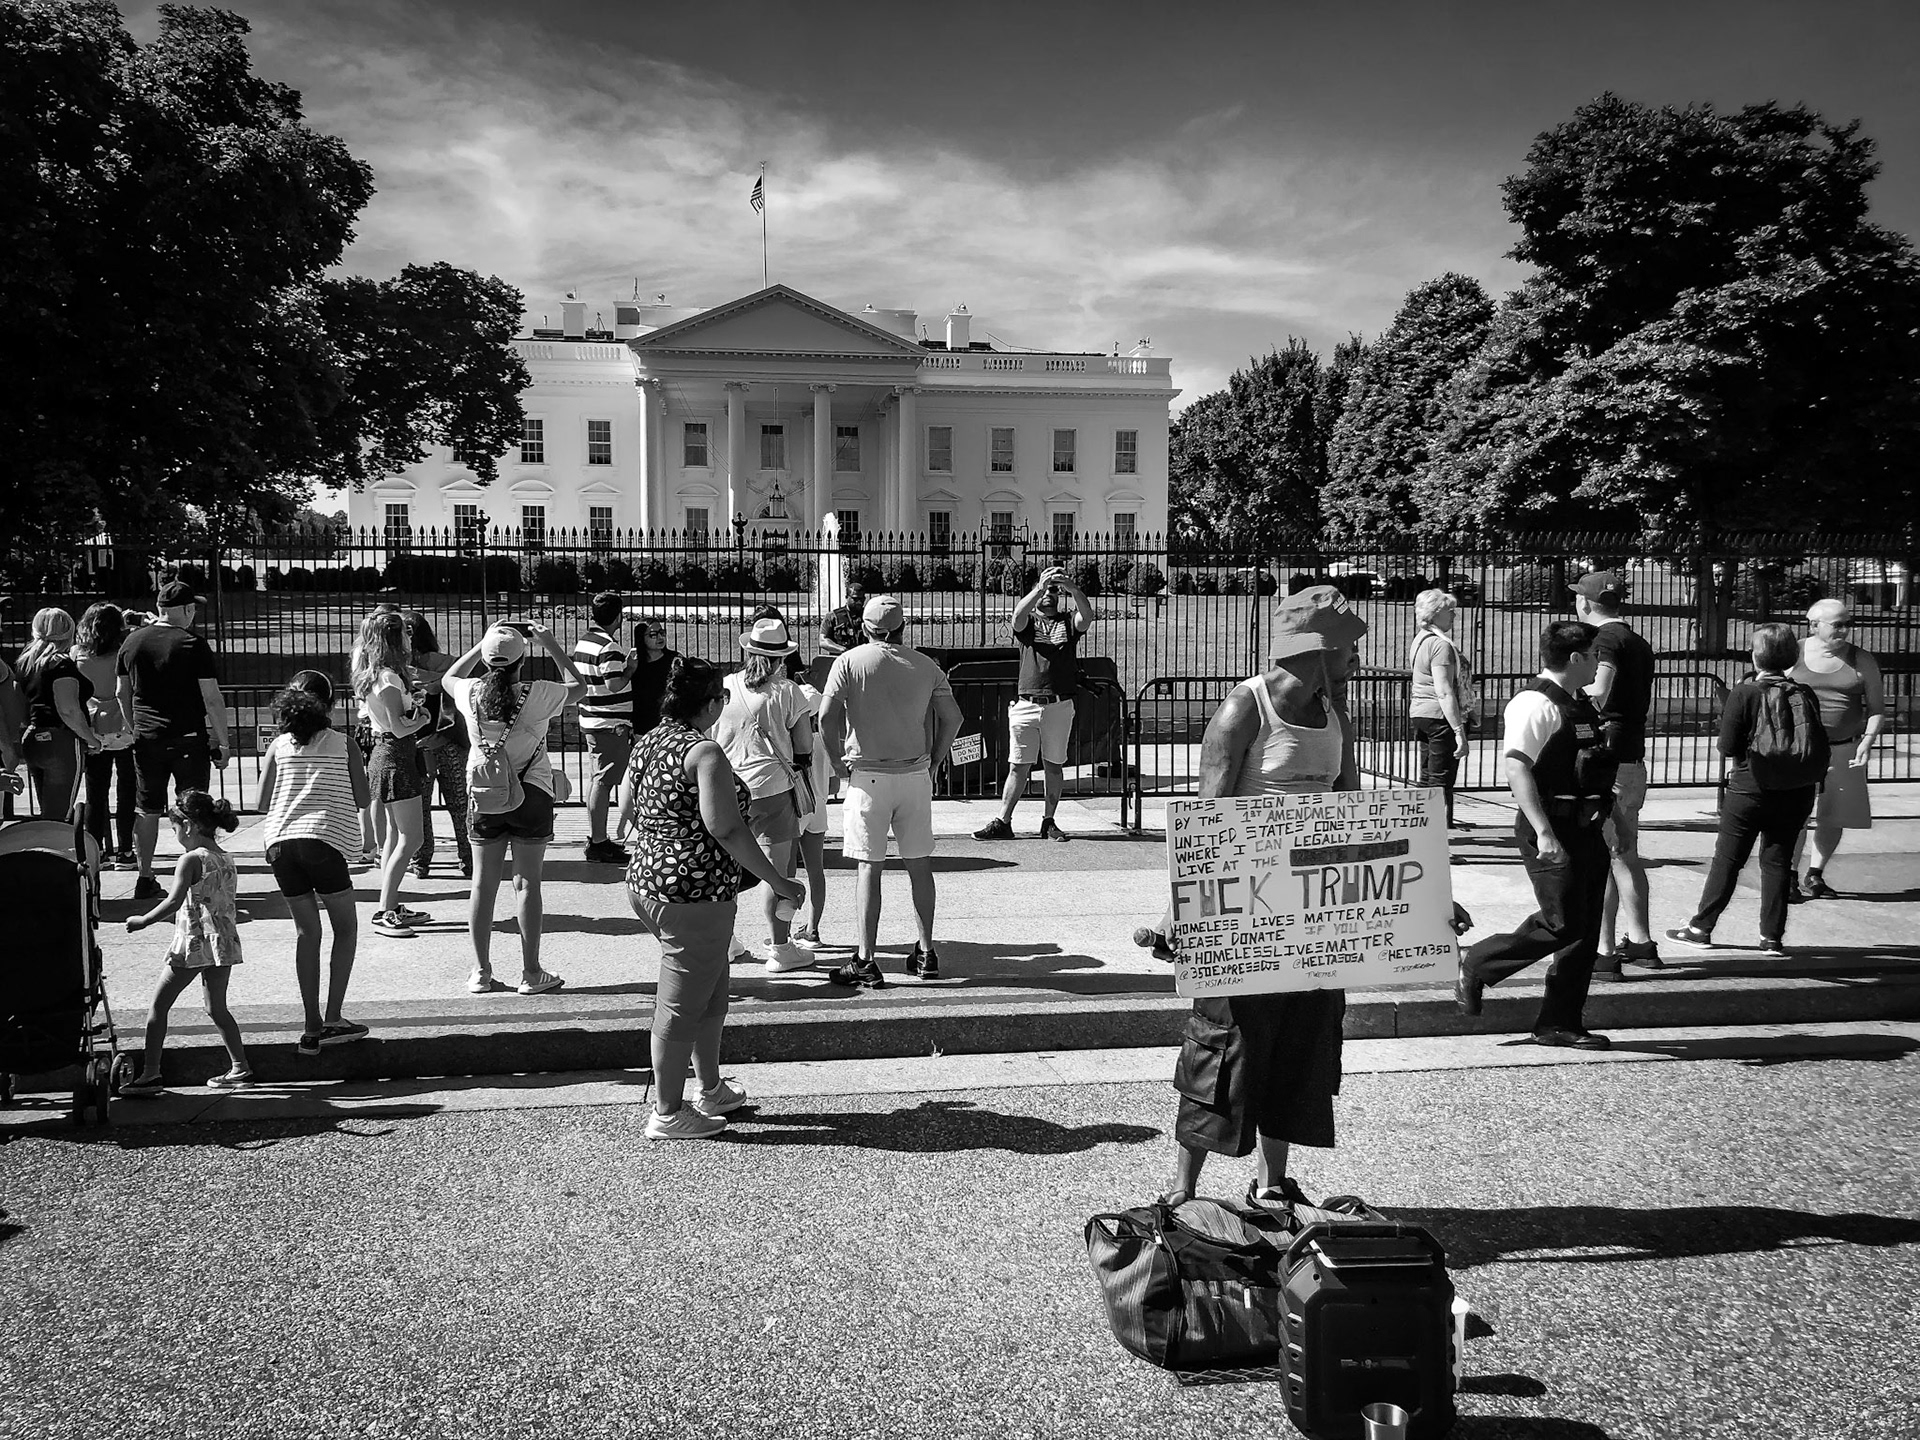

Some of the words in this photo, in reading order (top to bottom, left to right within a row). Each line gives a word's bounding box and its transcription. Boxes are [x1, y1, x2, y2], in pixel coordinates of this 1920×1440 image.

[960, 753, 981, 762] ENTER
[1170, 799, 1215, 813] THIS
[1236, 797, 1285, 810] SIGN
[1298, 794, 1323, 805] IS
[1338, 789, 1437, 804] PROTECTED
[1175, 817, 1190, 831] BY
[1198, 813, 1223, 826] THE
[1266, 805, 1359, 823] AMENDMENT
[1369, 803, 1388, 816] OF
[1398, 803, 1425, 815] THE
[1175, 827, 1236, 849] UNITED
[1246, 821, 1305, 839] STATES
[1314, 817, 1428, 832] CONSTITUTION
[1175, 847, 1220, 864] WHERE
[1233, 845, 1246, 855] I
[1255, 838, 1282, 852] CAN
[1294, 833, 1351, 847] LEGALLY
[1361, 831, 1391, 841] SAY
[1178, 861, 1215, 878] LIVE
[1223, 860, 1239, 872] AT
[1251, 855, 1279, 868] THE
[1171, 871, 1273, 921] FUCK
[1291, 860, 1424, 909] TRUMP
[1172, 919, 1239, 936] HOMELESS
[1252, 914, 1295, 928] LIVES
[1304, 907, 1365, 924] MATTER
[1372, 903, 1409, 919] ALSO
[1175, 934, 1223, 949] PLEASE
[1231, 929, 1285, 946] DONATE
[1305, 924, 1325, 935] IF
[1334, 922, 1358, 935] YOU
[1366, 919, 1394, 930] CAN
[1378, 944, 1451, 962] @HECTA350
[1195, 977, 1244, 990] INSTAGRAM
